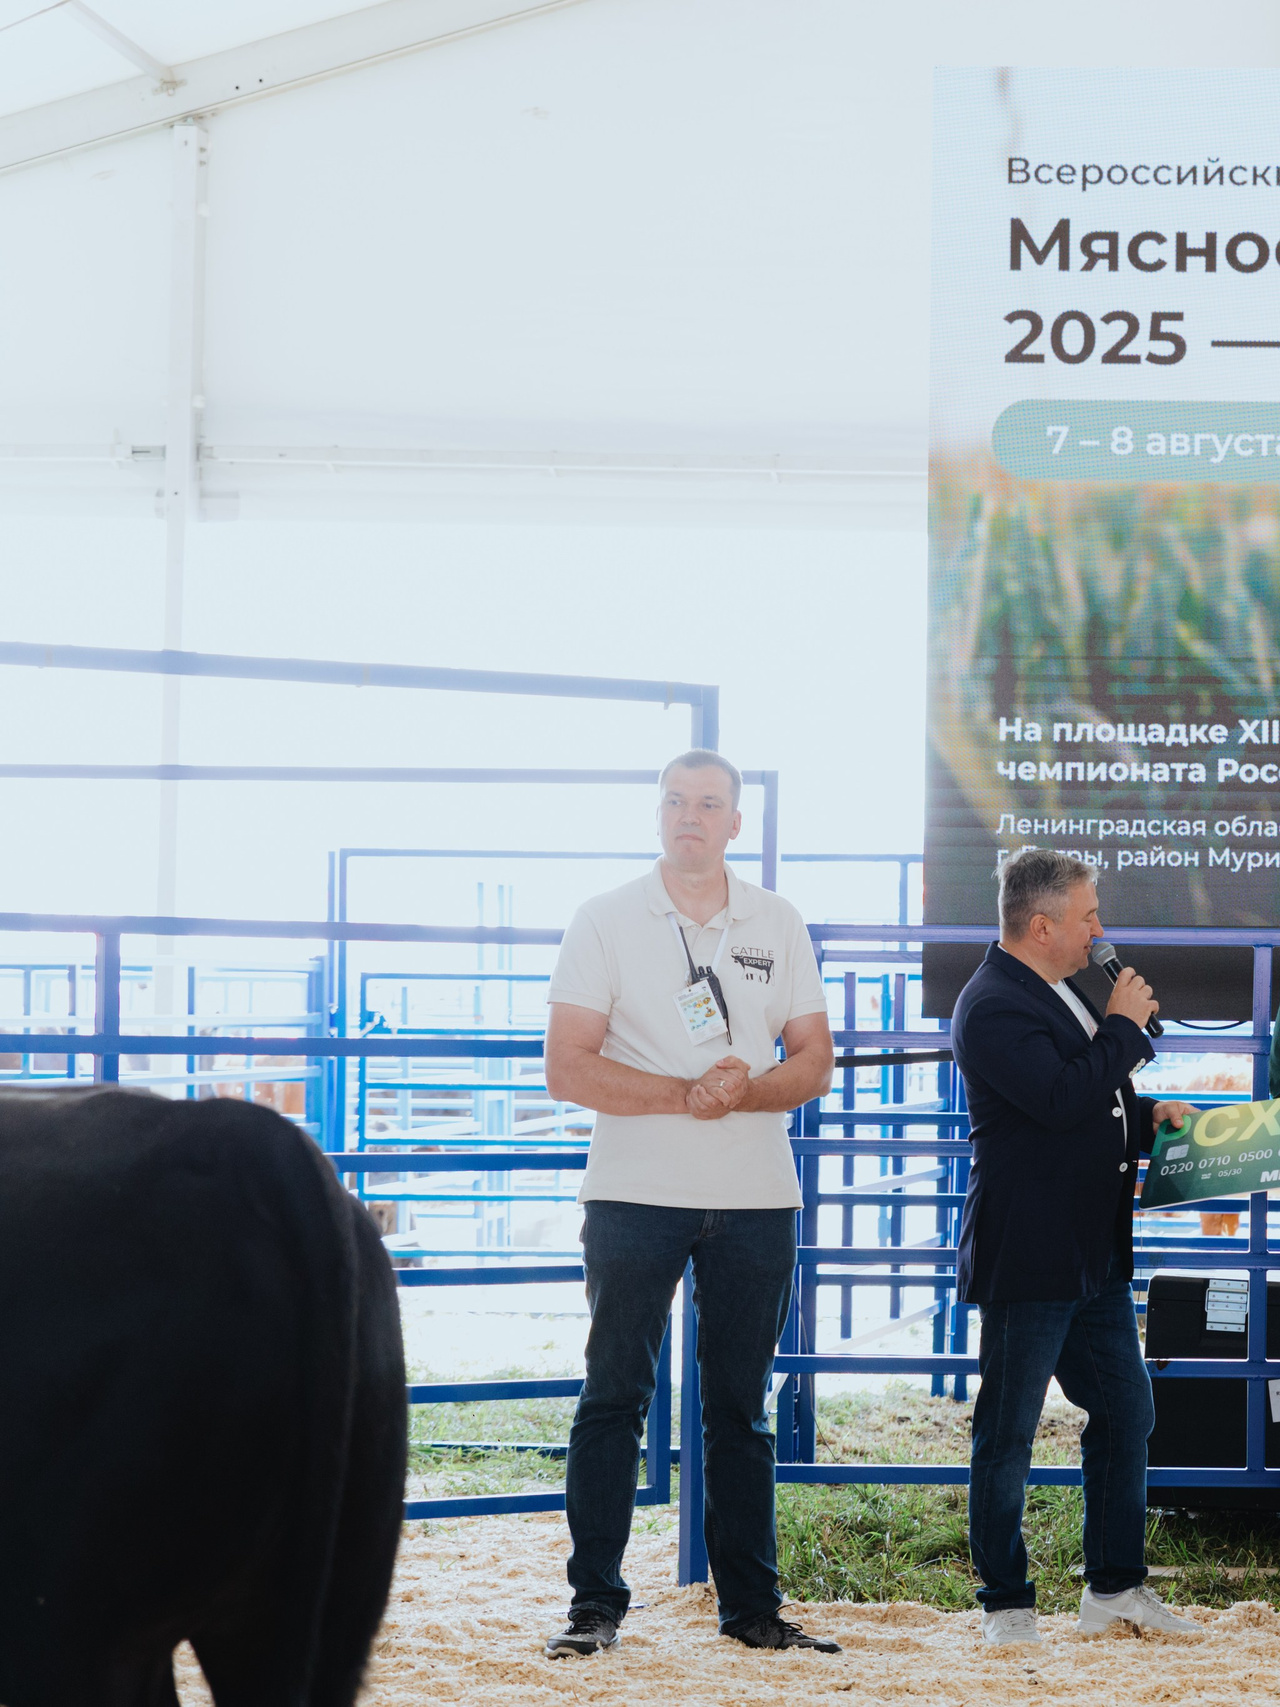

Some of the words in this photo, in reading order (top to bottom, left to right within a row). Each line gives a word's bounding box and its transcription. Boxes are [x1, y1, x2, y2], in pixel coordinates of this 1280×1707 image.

[1003, 308, 1188, 366] 2025
[1045, 425, 1071, 455] 7
[1109, 426, 1135, 456] 8
[998, 717, 1043, 743] На
[1052, 721, 1229, 747] площадке
[996, 760, 1207, 783] чемпионата
[996, 813, 1207, 839] Ленинградская
[1116, 846, 1200, 871] район
[730, 946, 775, 959] CATTLE
[743, 958, 772, 967] EXPERT
[1160, 1161, 1194, 1176] 0220
[1198, 1155, 1231, 1169] 0710
[1238, 1148, 1273, 1163] 0500
[1217, 1167, 1243, 1178] 05/30
